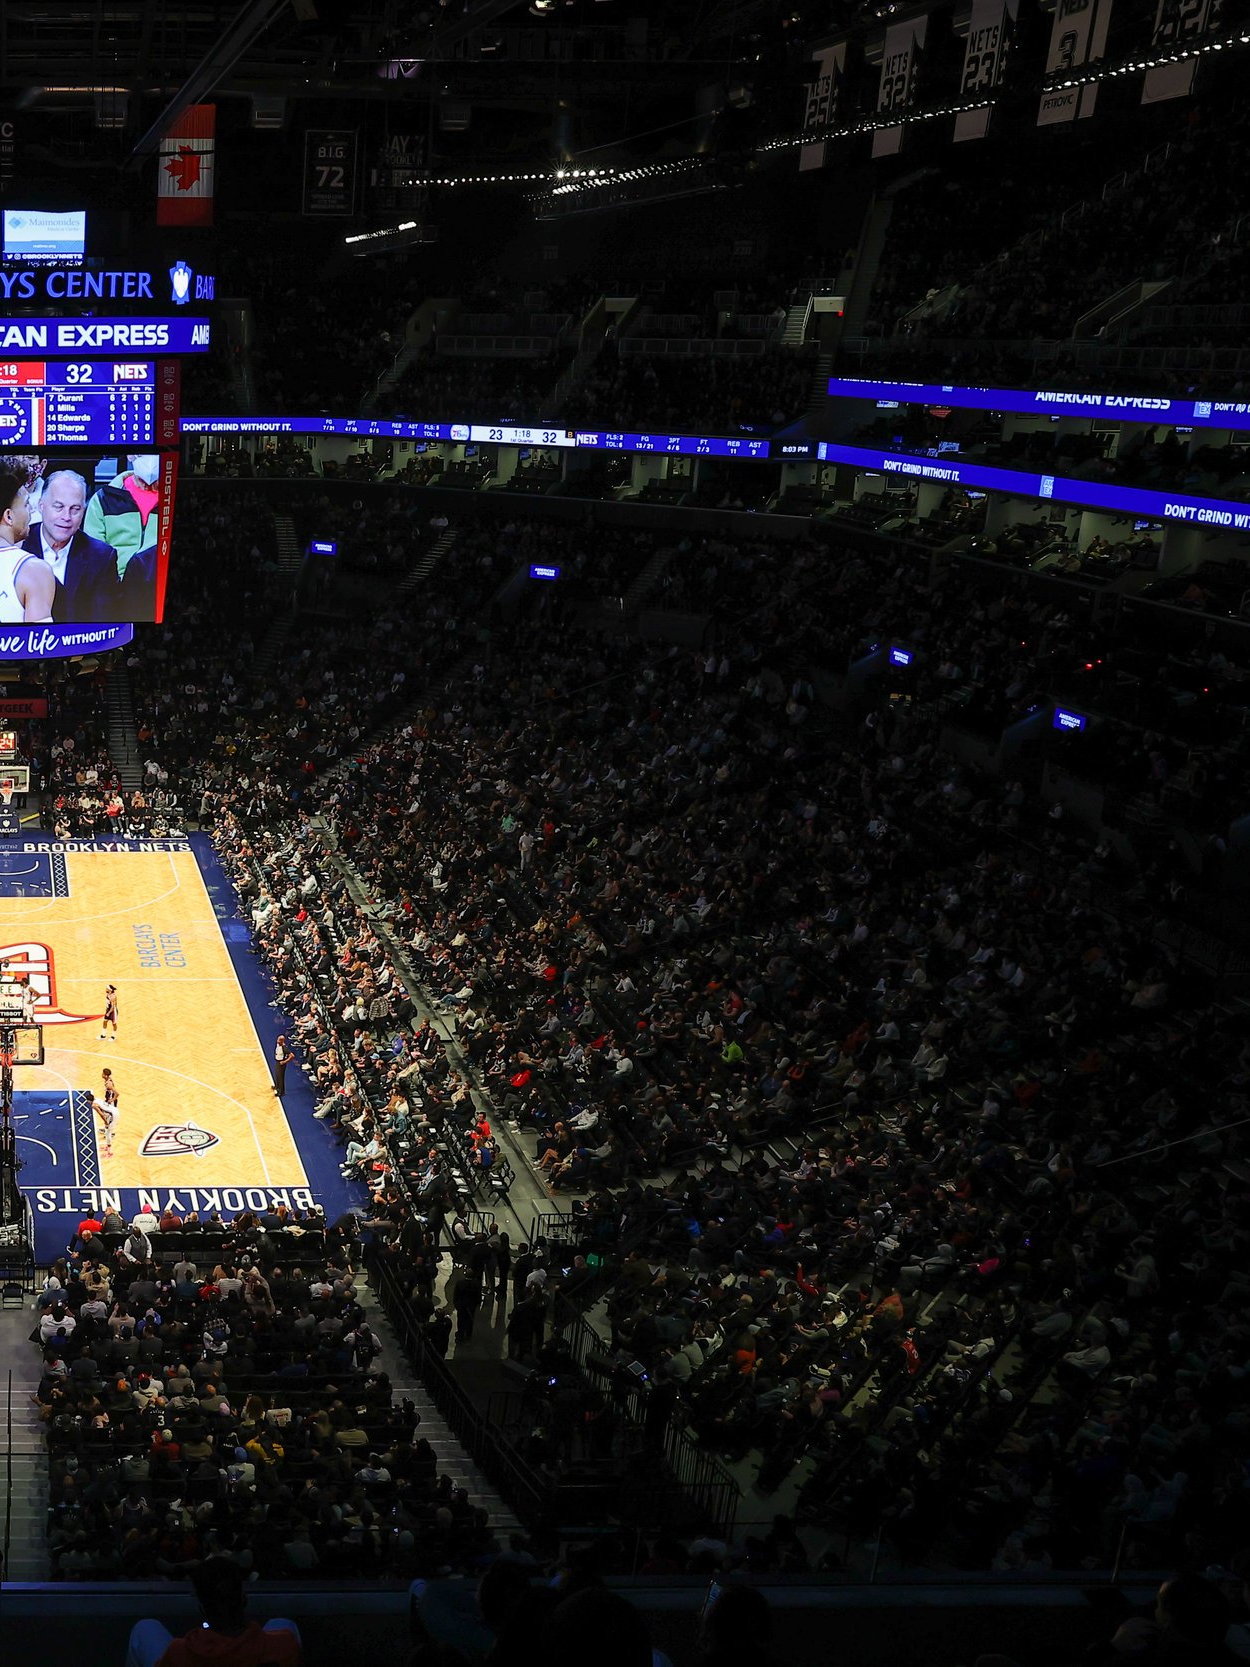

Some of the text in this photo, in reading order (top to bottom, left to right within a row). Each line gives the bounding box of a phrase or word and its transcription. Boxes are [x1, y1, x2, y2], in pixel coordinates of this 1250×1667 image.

[969, 25, 999, 54] NETS
[1058, 29, 1078, 71] 3
[885, 51, 909, 77] NETS
[964, 54, 994, 88] 23
[880, 75, 907, 110] 32
[1042, 94, 1074, 110] PETROVIC
[315, 166, 344, 188] 72
[29, 217, 81, 227] Maimonides
[45, 271, 154, 299] CENTER
[57, 324, 169, 347] EXPRESS
[66, 364, 93, 384] 32
[113, 364, 148, 384] NETS
[57, 394, 84, 402] Durant
[57, 424, 85, 433] Sharpe
[182, 423, 292, 431] DON'T GRIND WITHOUT IT.
[489, 428, 503, 441] 23
[514, 430, 531, 438] 1:18
[567, 431, 573, 439] B
[606, 433, 619, 441] FLS:
[542, 431, 557, 444] 32
[576, 433, 599, 447] NETS
[726, 440, 741, 448] REB
[748, 441, 762, 449] AST
[782, 445, 798, 453] 8:03
[883, 459, 902, 472] DON'T
[901, 463, 922, 475] GRIND
[922, 465, 952, 481] WITHOUT
[161, 460, 172, 536] BIOSTEEL
[1163, 503, 1233, 525] DON'T GRIND
[27, 628, 61, 654] life
[61, 630, 107, 646] WITHOUT
[0, 738, 13, 750] 24
[23, 842, 192, 853] BROOKLYN NETS
[132, 924, 162, 968] BARCLAYS
[158, 930, 187, 968] CENTER
[37, 1187, 315, 1213] BROOKLYN NETS
